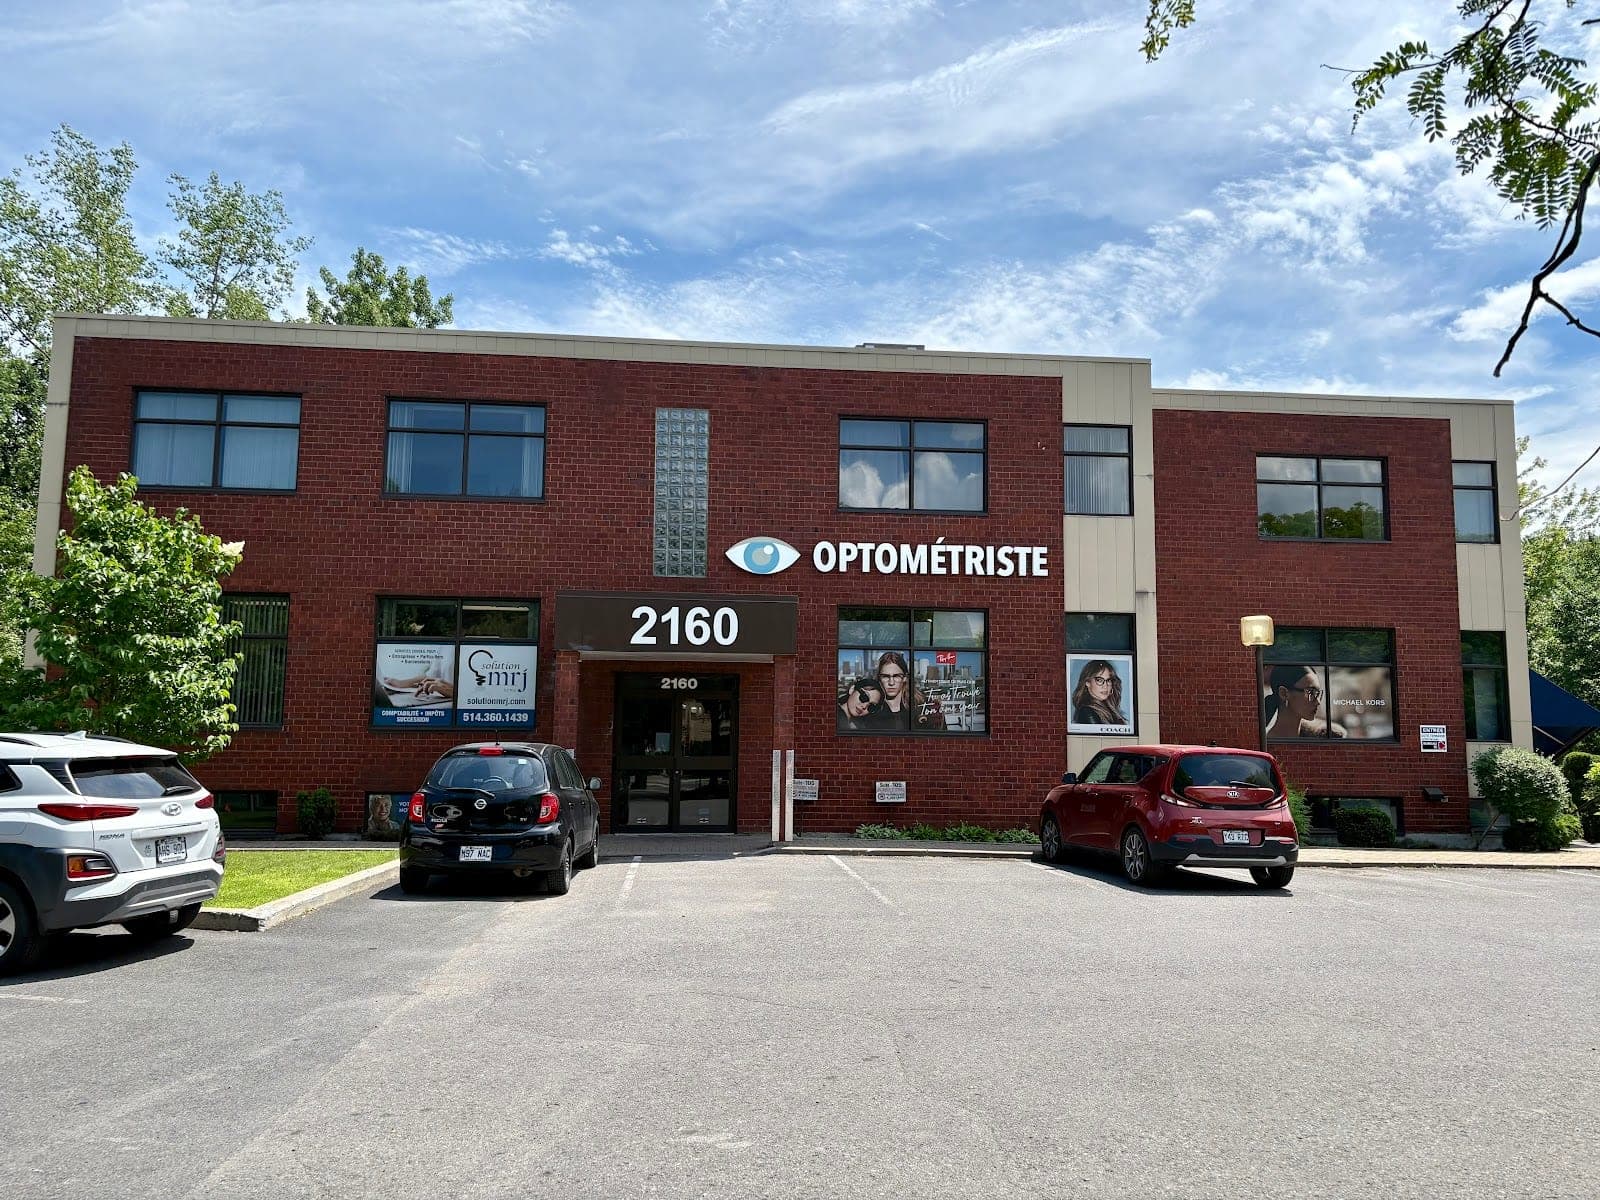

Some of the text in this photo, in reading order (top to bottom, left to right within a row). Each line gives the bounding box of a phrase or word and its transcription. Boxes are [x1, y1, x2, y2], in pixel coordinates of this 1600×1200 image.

[813, 537, 1049, 576] OPTOMÉTRISTE
[630, 606, 739, 646] 2160
[481, 661, 520, 670] solution
[488, 669, 528, 692] mrj
[661, 677, 698, 690] 2160
[467, 697, 526, 706] solutionmrj.com
[381, 709, 445, 717] COMPTABILITÉ IMPÔTS
[463, 712, 529, 722] 514.360.1439
